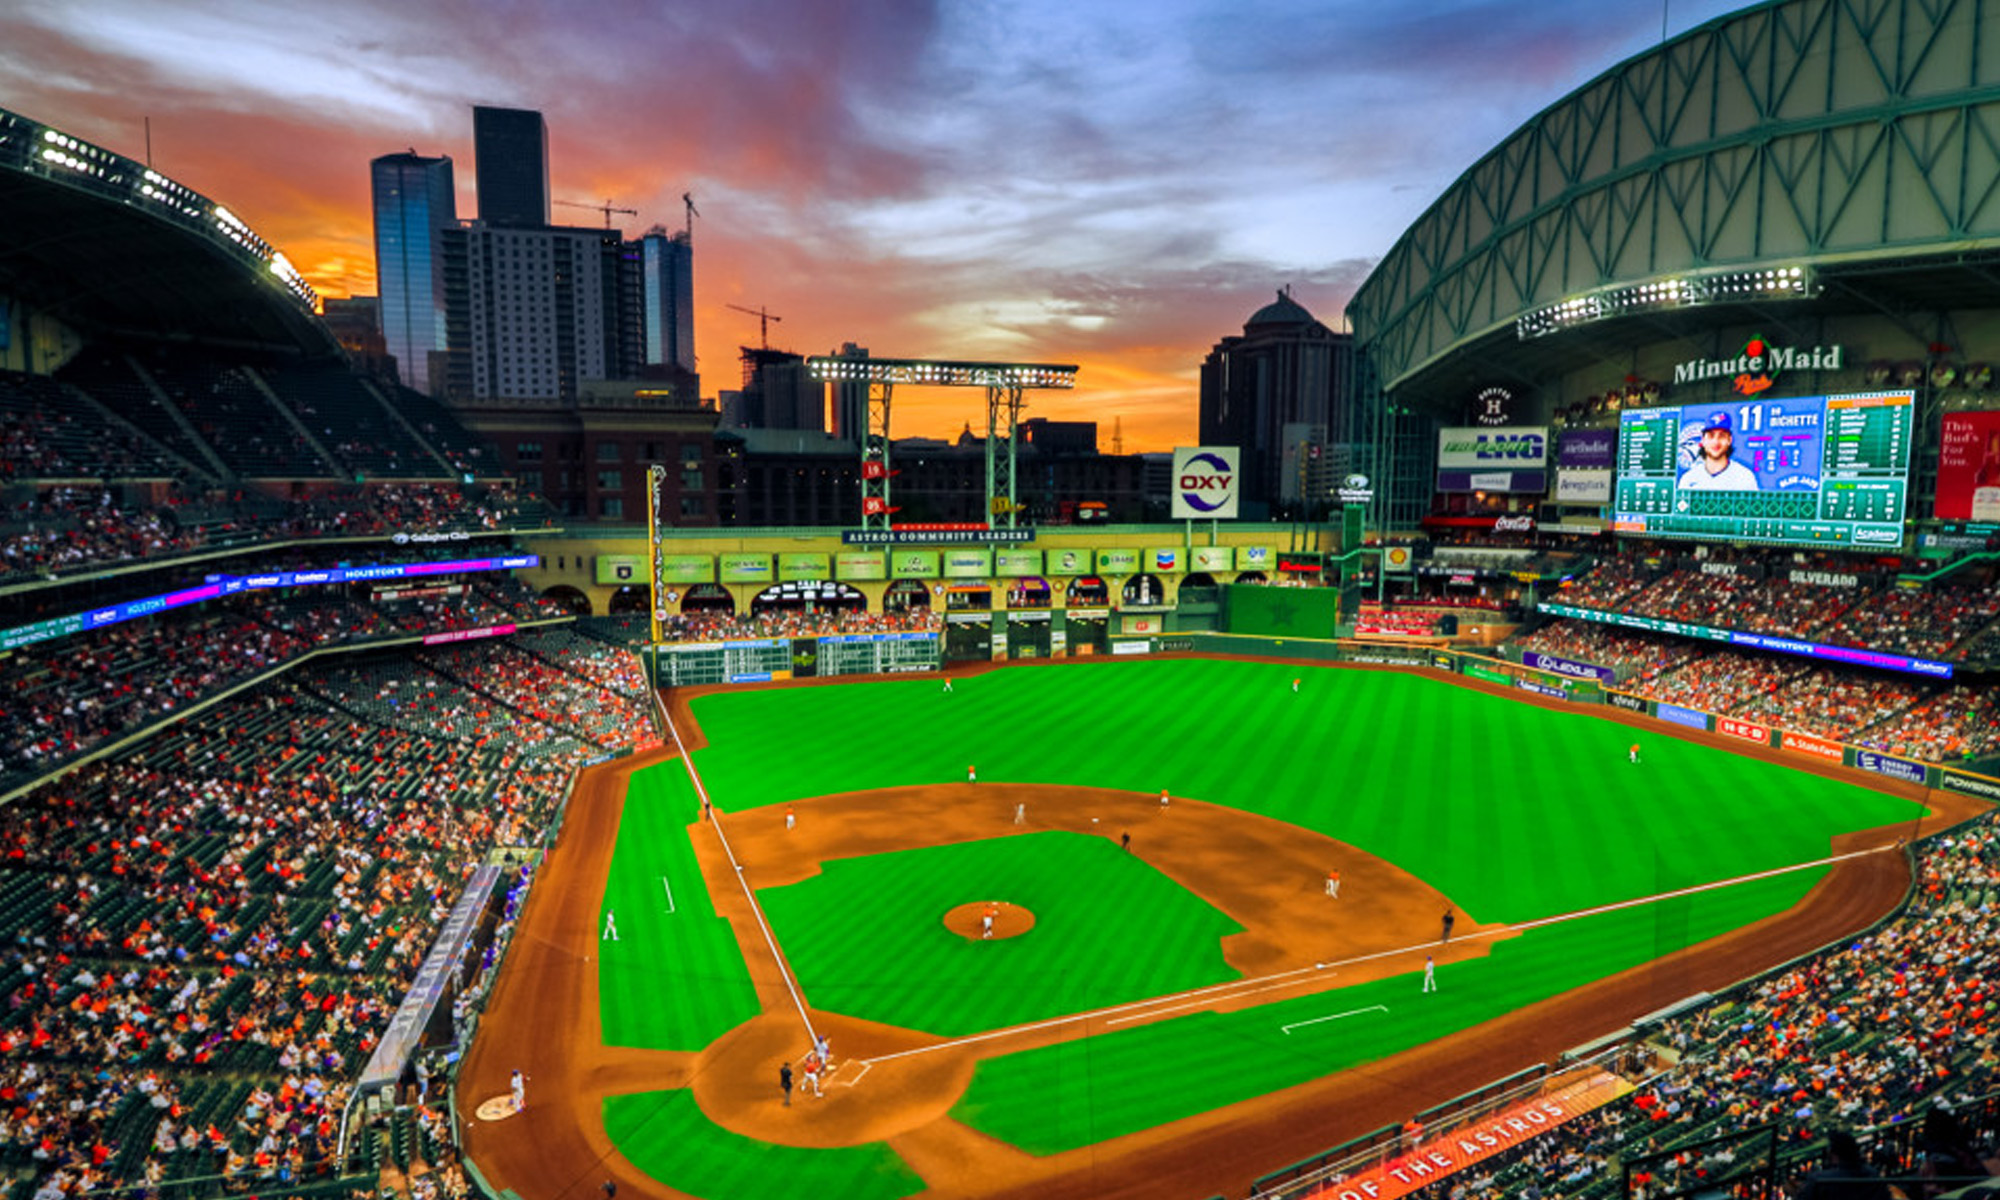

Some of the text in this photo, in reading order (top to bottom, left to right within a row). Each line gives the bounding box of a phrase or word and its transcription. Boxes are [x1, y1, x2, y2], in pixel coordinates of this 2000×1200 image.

[1674, 345, 1840, 385] Minute Maid
[1487, 400, 1501, 414] H
[1740, 404, 1762, 431] 11
[1770, 413, 1818, 427] BICHETTE
[1945, 421, 1973, 431] This
[1944, 432, 1979, 442] Bud's
[1477, 434, 1544, 459] LNG
[1943, 445, 1964, 454] For
[1942, 455, 1969, 466] You.
[1180, 475, 1232, 490] OXY
[849, 531, 1029, 541] ASTROS COMMUNITY LEADERS
[1701, 563, 1737, 575] CHEVY
[1789, 570, 1857, 587] SILVERADO
[1552, 659, 1598, 678] LEXUS
[1339, 1102, 1565, 1200] OF THE ASTROS
